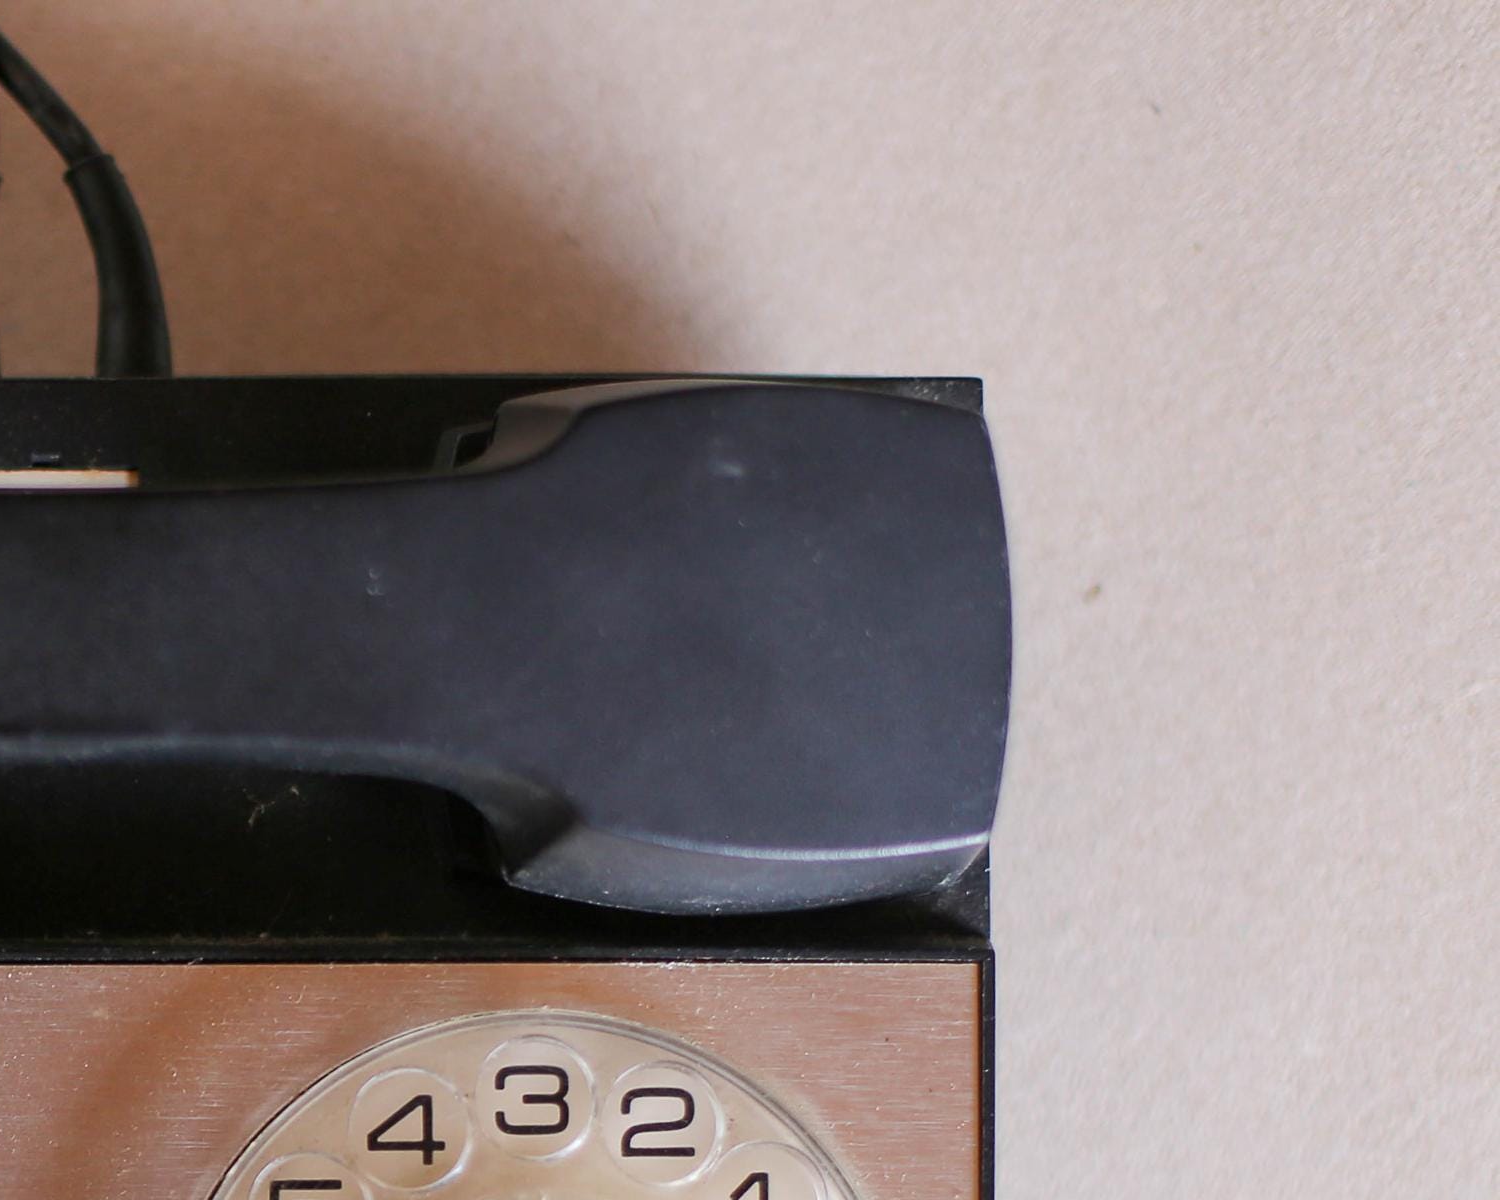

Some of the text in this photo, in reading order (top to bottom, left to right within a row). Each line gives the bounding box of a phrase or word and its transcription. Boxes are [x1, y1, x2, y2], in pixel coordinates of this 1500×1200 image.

[366, 1095, 446, 1165] 4
[494, 1065, 570, 1135] 3
[620, 1087, 696, 1157] 2
